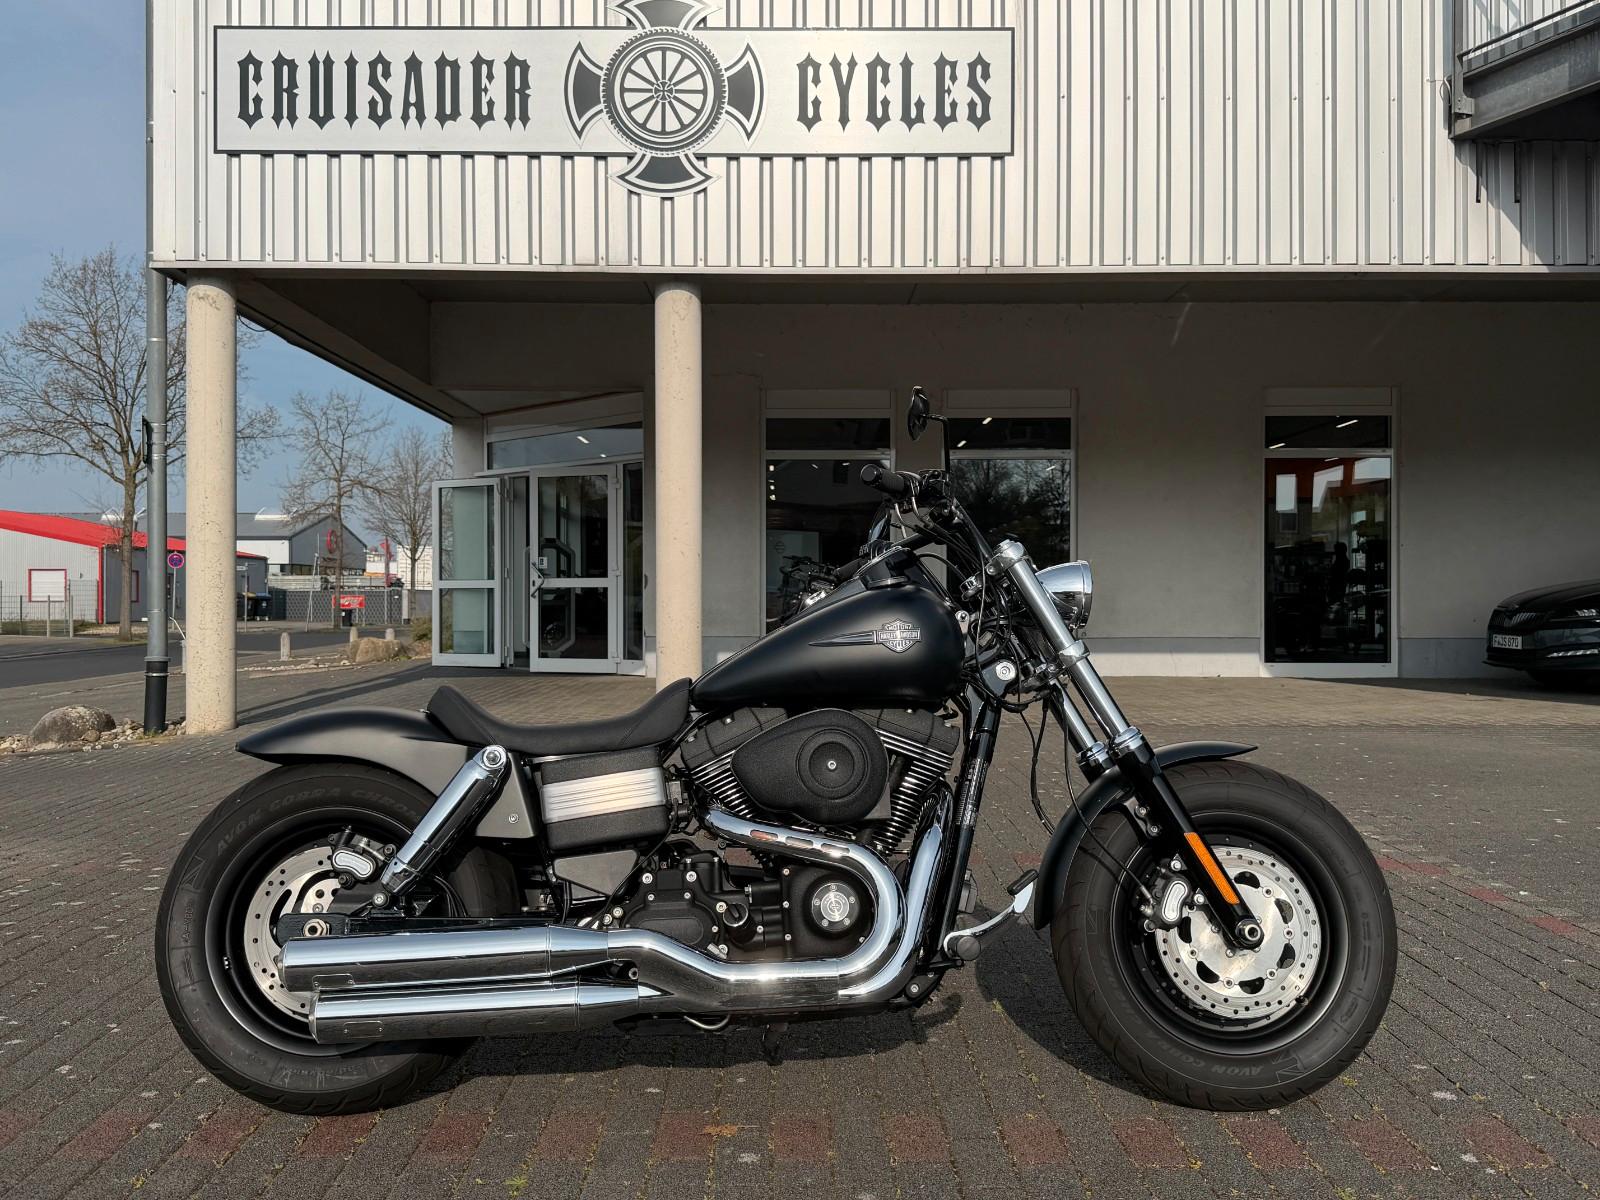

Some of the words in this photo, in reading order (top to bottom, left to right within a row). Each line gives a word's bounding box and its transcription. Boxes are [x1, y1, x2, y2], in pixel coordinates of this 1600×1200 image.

[237, 49, 532, 131] CRUISADER
[796, 51, 992, 133] CYCLES
[1210, 1063, 1265, 1076] AVON
